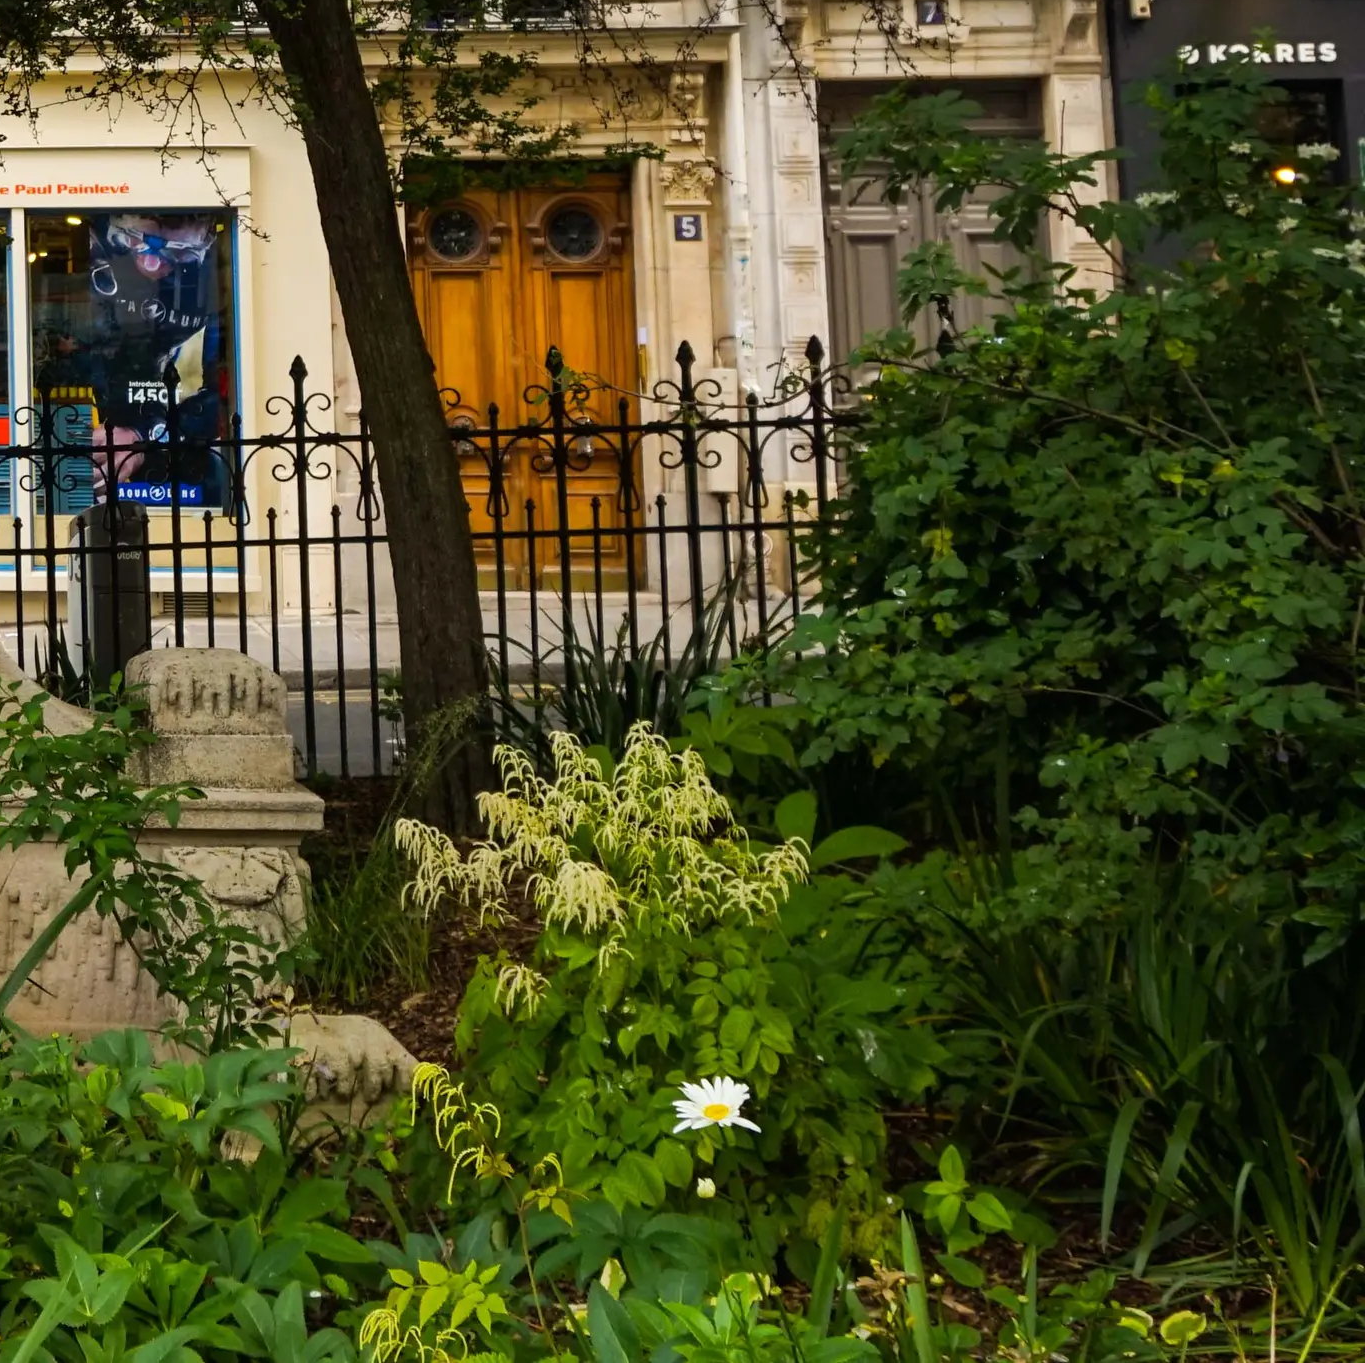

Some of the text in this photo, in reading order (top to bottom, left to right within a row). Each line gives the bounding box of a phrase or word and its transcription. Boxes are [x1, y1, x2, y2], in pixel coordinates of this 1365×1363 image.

[923, 1, 937, 23] 7
[15, 184, 52, 195] Paul
[57, 182, 130, 195] Painlevé
[681, 216, 696, 238] 5
[129, 380, 166, 388] Introducin
[118, 487, 196, 499] AQUA LNG
[116, 550, 142, 560] utolib'
